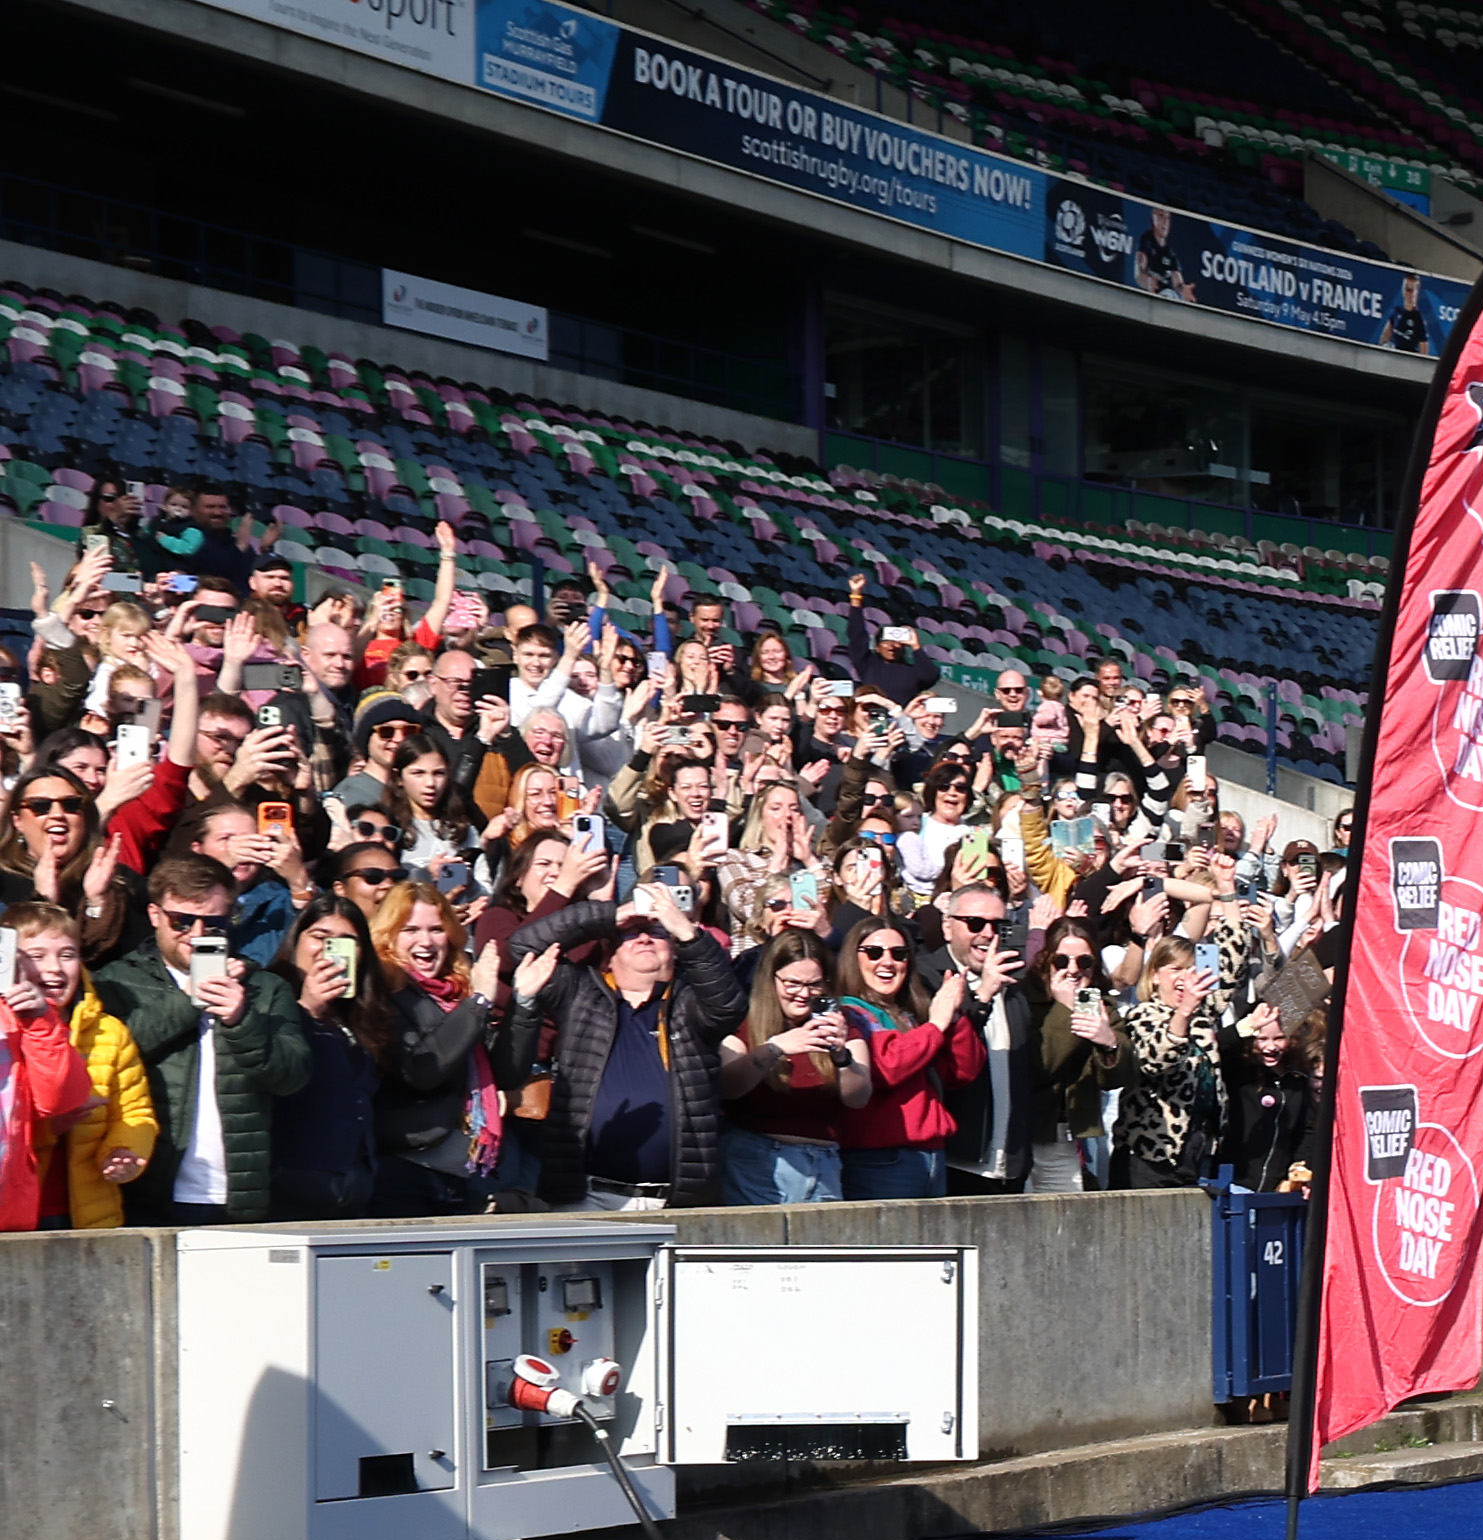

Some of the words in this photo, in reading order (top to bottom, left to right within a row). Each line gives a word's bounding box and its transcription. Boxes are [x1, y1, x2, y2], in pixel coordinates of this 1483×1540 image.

[484, 62, 547, 94] STADIUM
[634, 47, 703, 100] BOOK
[701, 71, 723, 106] A
[723, 78, 783, 131] TOUR
[786, 101, 818, 141] OR
[821, 111, 863, 154] BUY
[864, 126, 971, 192] VOUCHERS
[973, 163, 1033, 210] NOW!
[741, 134, 937, 215] scottishrugby.org/tours
[1201, 249, 1295, 299] SCOTLAND
[1299, 280, 1311, 302] v
[1312, 278, 1383, 319] FRANCE
[1235, 290, 1281, 321] Saturday
[1282, 300, 1292, 318] 9
[1294, 303, 1313, 326] May
[1429, 636, 1476, 661] RELIEF
[1397, 861, 1438, 887] COMIC
[1397, 883, 1439, 910] RELIEF
[1436, 901, 1483, 951] RED
[1427, 989, 1479, 1034] DAY
[1365, 1106, 1412, 1140] COMIC
[1403, 1148, 1452, 1198] RED
[1394, 1187, 1456, 1243] NOSE
[1262, 1240, 1283, 1266] 42
[1400, 1238, 1443, 1280] DAY
